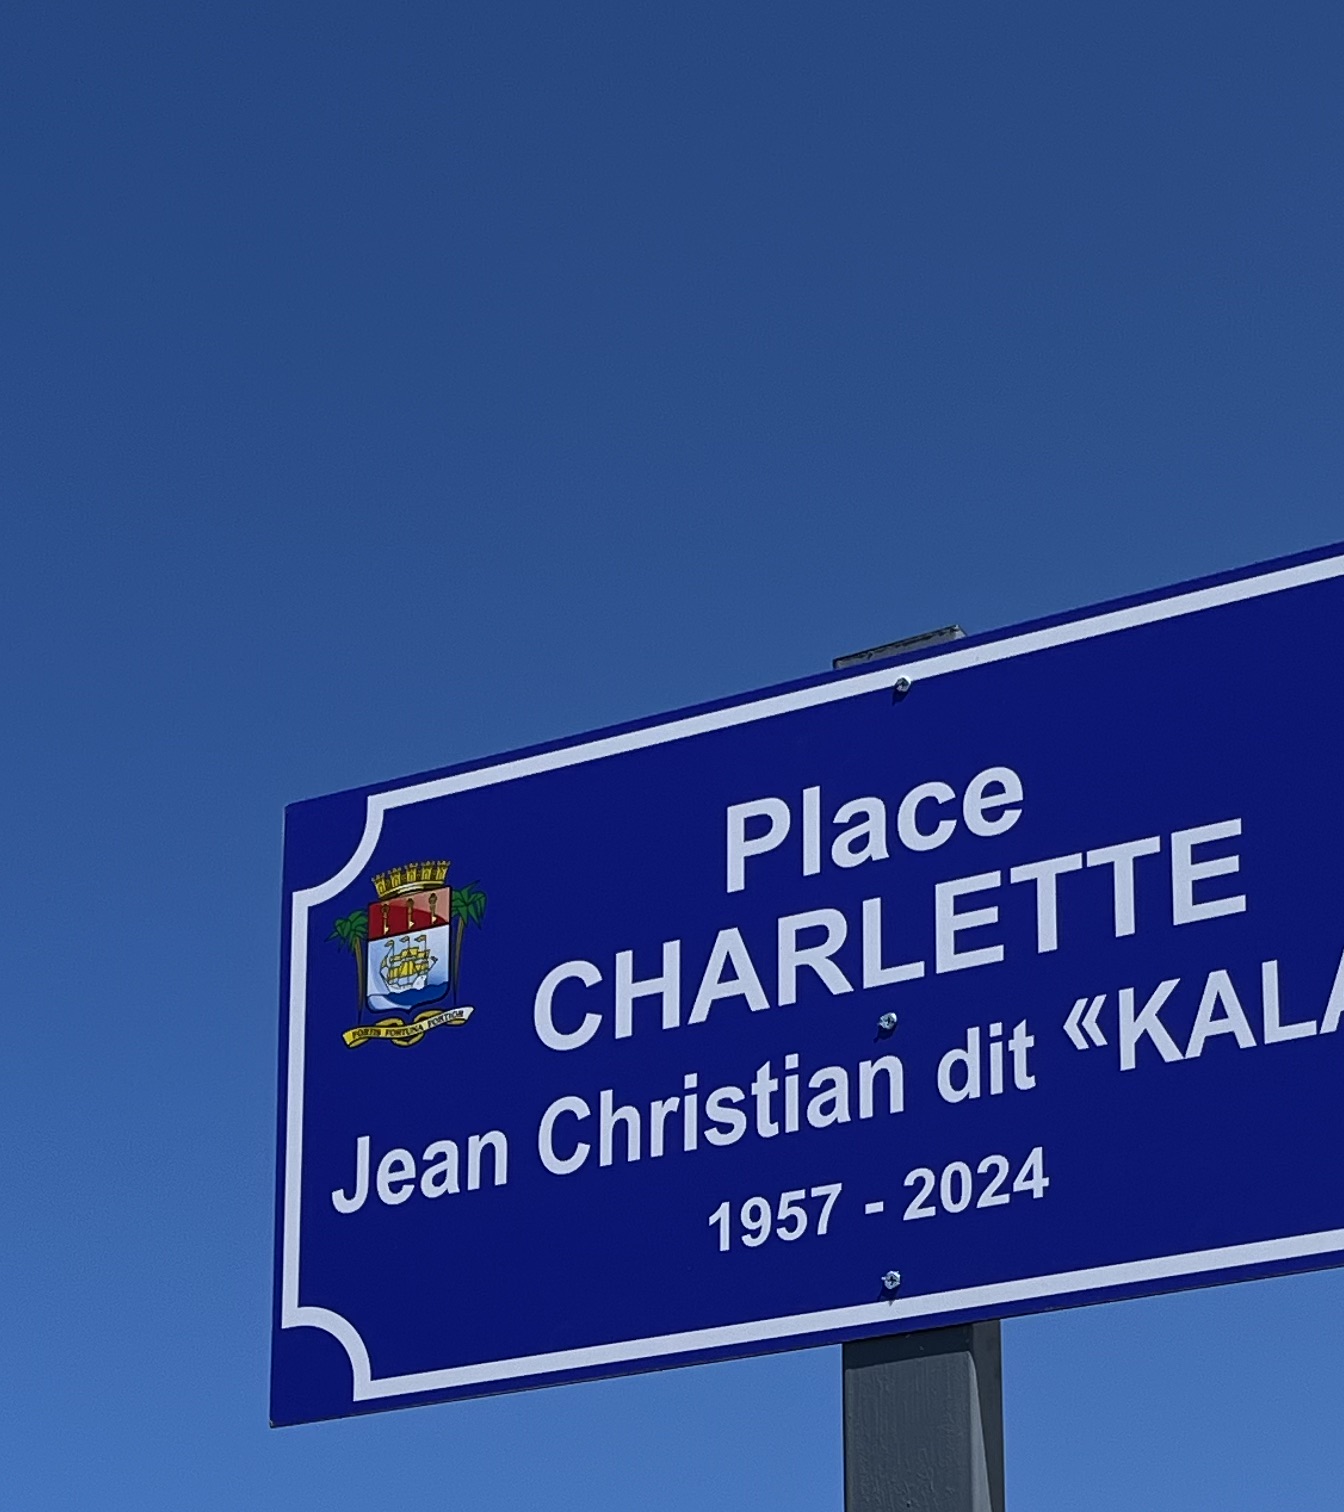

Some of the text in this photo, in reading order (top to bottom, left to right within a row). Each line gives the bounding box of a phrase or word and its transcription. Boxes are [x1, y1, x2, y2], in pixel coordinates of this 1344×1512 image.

[727, 767, 1023, 893] Place
[535, 818, 1246, 1050] CHARLETTE
[385, 1024, 424, 1037] FORTUNA
[332, 1131, 507, 1213] Jean
[539, 1054, 903, 1174] Christian
[938, 1020, 1036, 1102] dit
[709, 1147, 1049, 1251] 1957 - 2024
